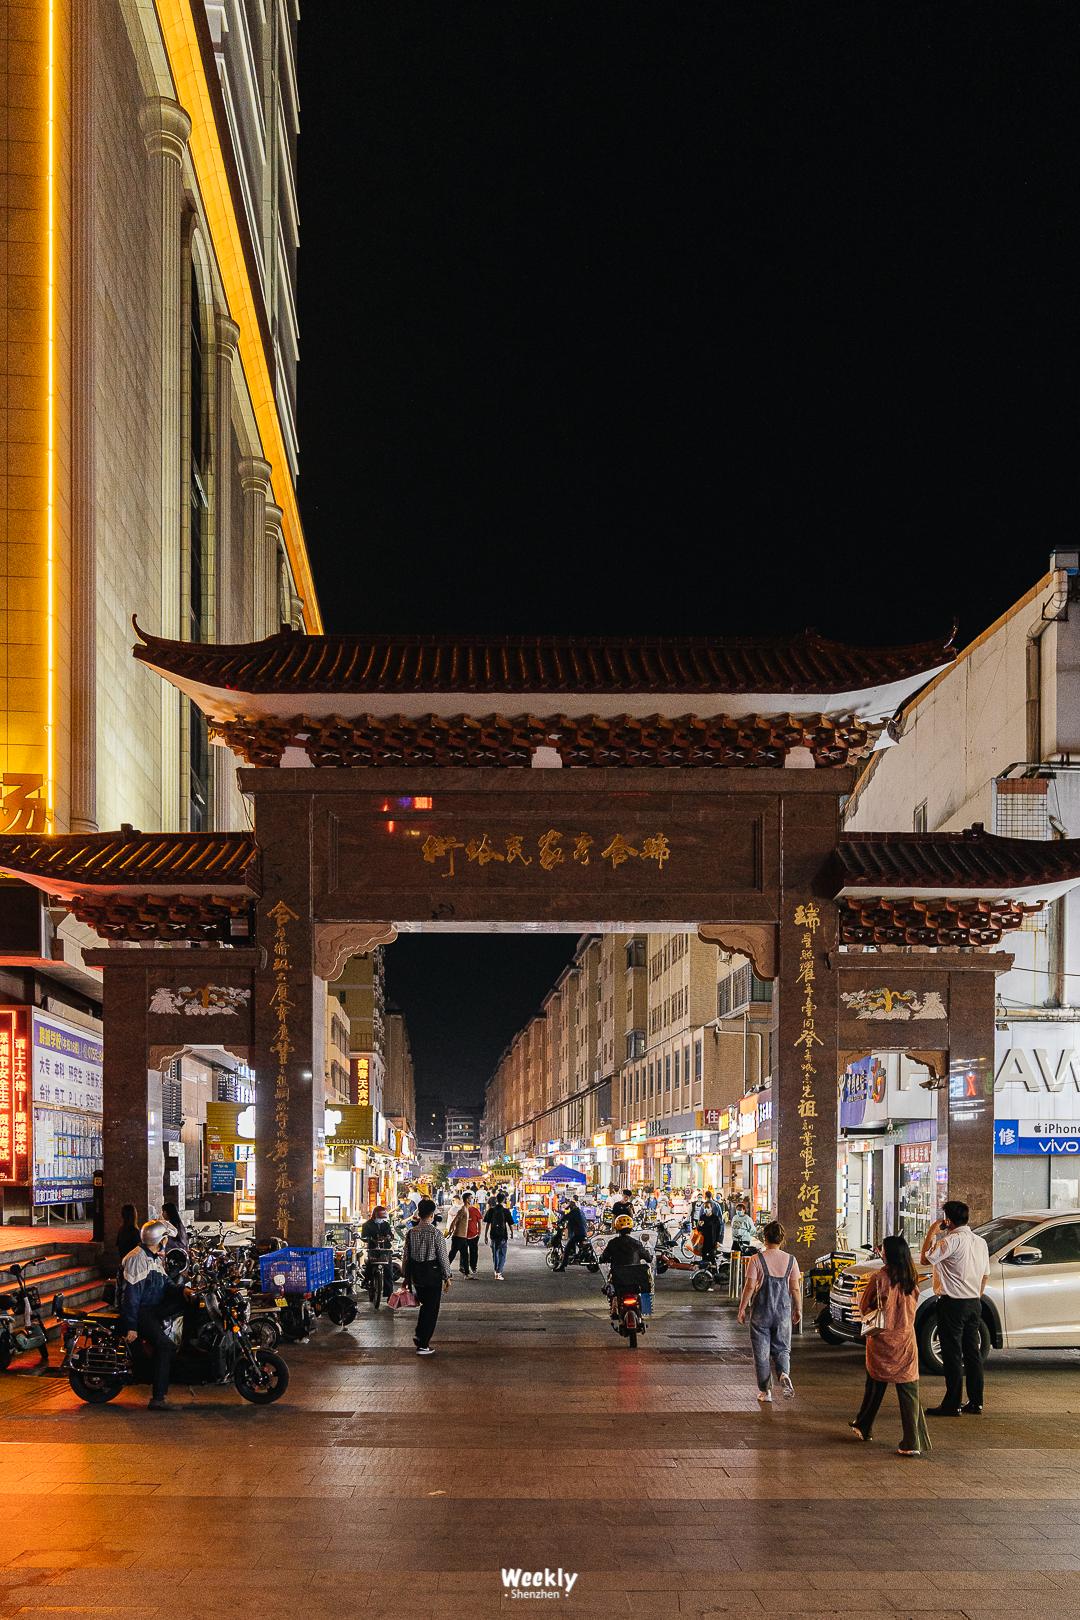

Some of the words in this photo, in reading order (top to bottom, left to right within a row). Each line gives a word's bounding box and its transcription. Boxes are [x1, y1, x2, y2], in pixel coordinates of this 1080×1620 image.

[706, 1110, 719, 1124] 住
[994, 1127, 1016, 1146] 修
[1038, 1138, 1079, 1152] vivo
